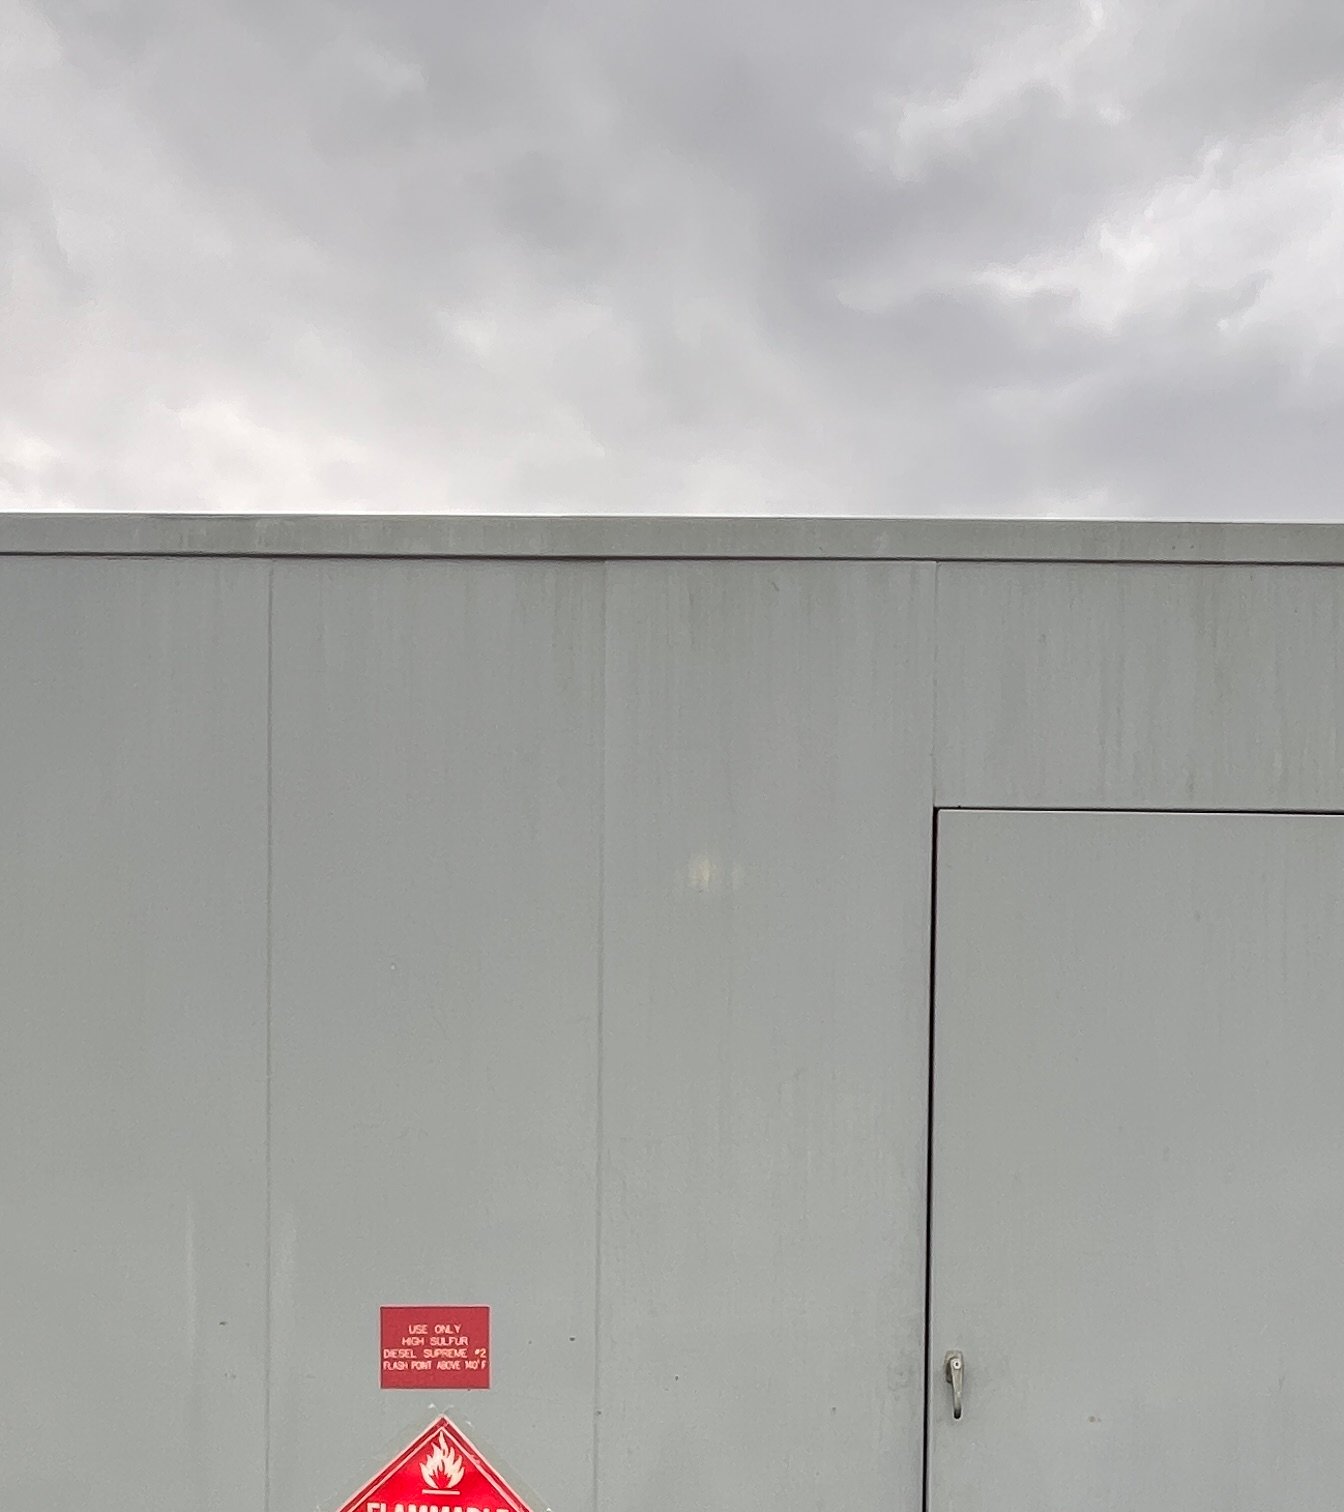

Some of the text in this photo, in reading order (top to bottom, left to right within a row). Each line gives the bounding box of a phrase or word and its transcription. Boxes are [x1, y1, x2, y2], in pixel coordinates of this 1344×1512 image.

[408, 1324, 462, 1334] USE ONLY
[401, 1336, 469, 1346] HIGH SULFUR
[383, 1348, 417, 1359] DIESEL
[423, 1348, 468, 1358] SUPREME
[383, 1361, 408, 1371] FLASH
[411, 1361, 432, 1370] POINT
[436, 1361, 461, 1370] ABOVE
